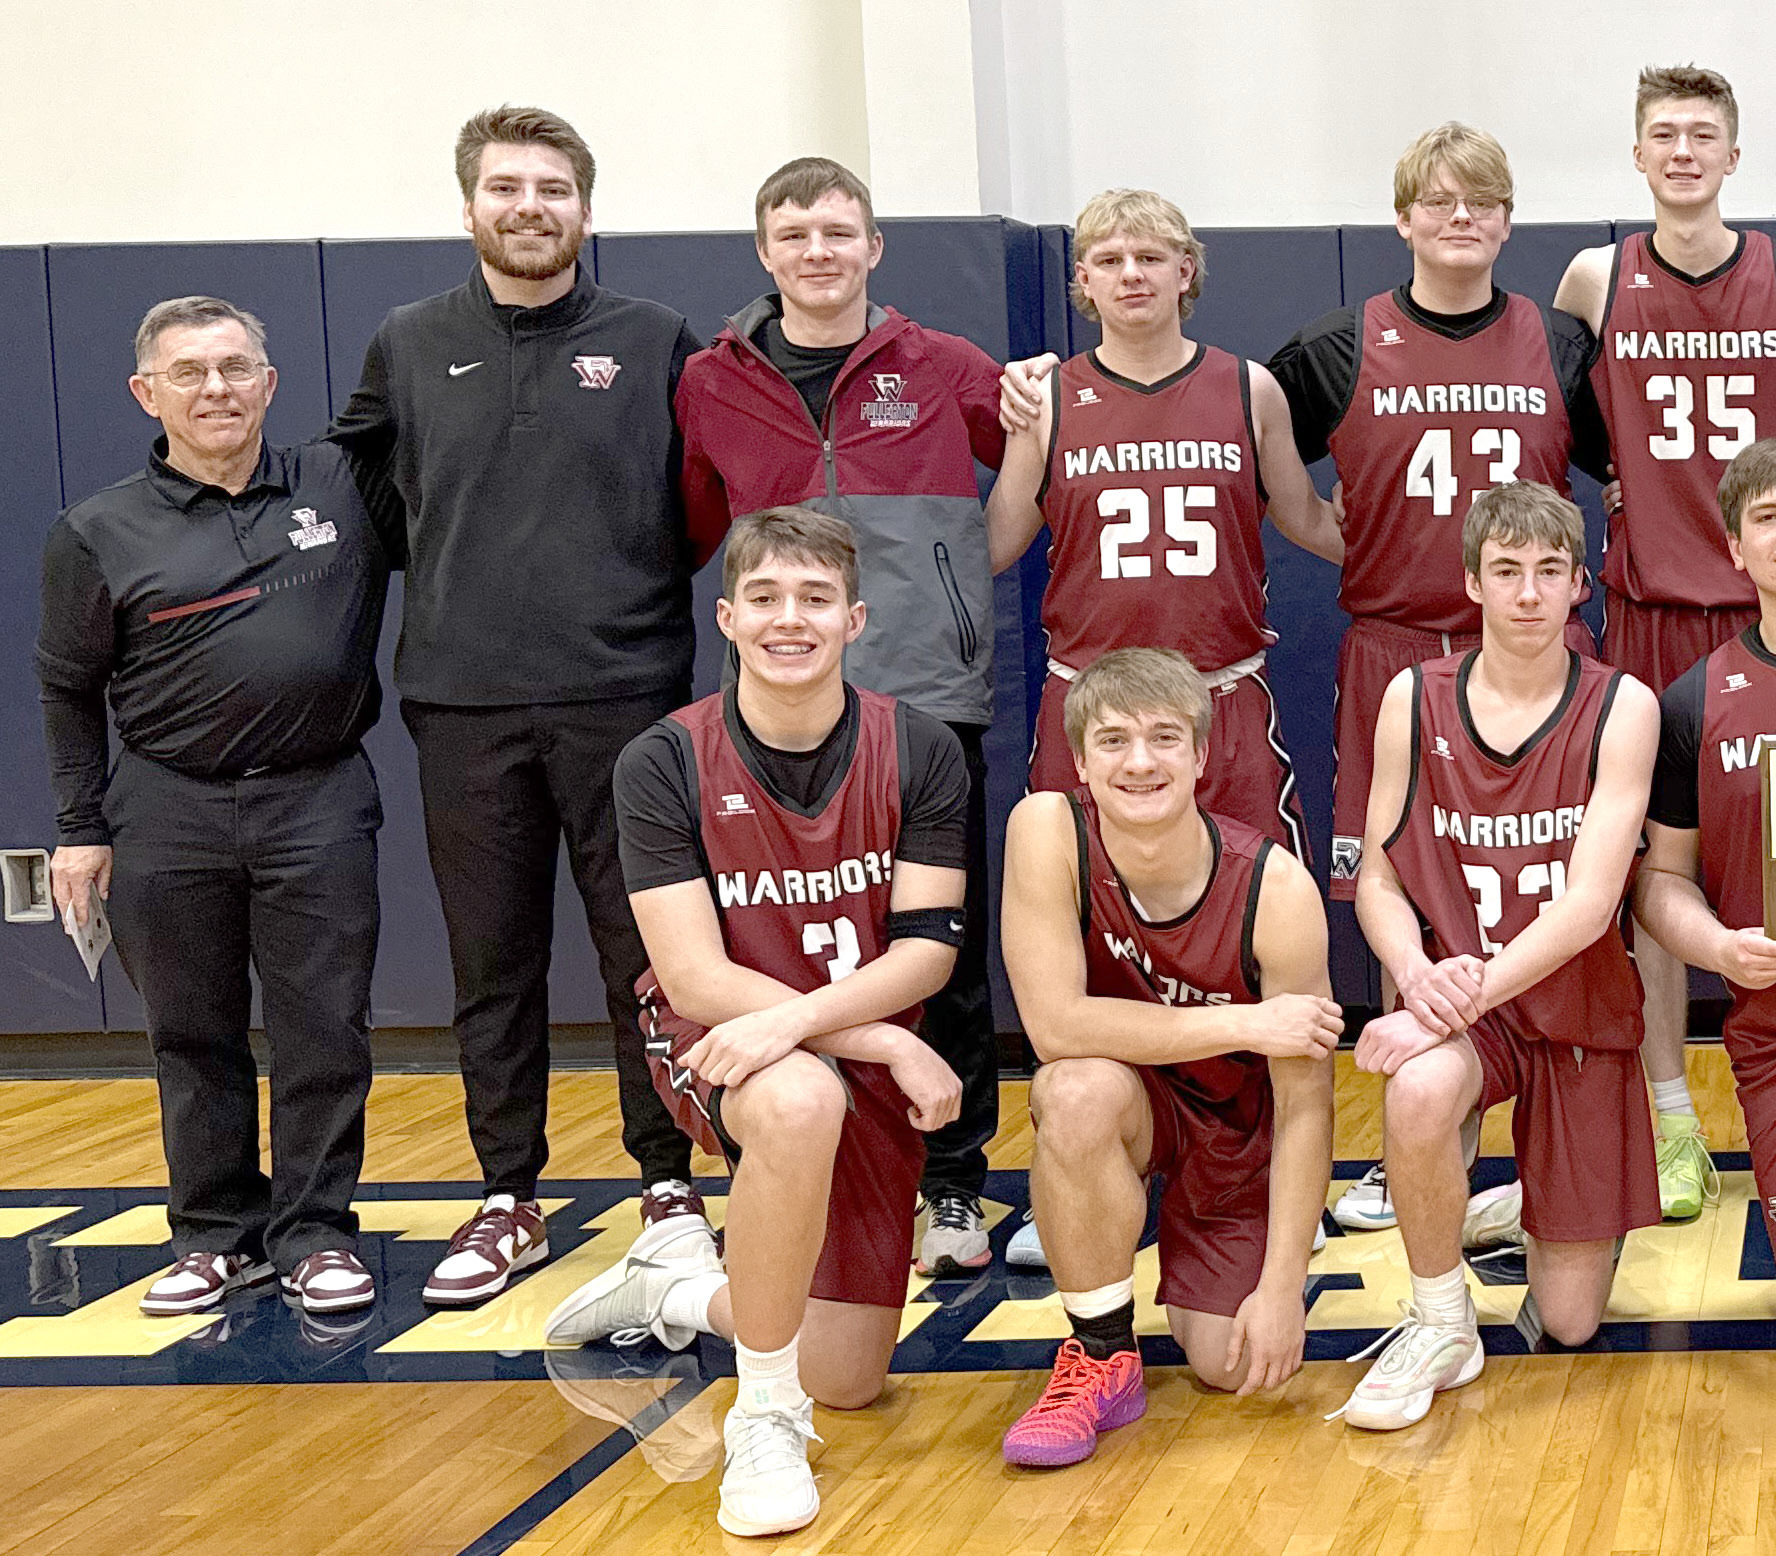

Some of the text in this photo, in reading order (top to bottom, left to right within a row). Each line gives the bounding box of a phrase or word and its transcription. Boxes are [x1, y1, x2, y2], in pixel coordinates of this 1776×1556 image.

[1373, 384, 1547, 416] WARRIORS
[1646, 375, 1756, 459] 35
[1065, 440, 1241, 479] WARRIORS
[1405, 428, 1521, 516] 43
[1097, 485, 1217, 579] 25
[1433, 804, 1585, 848] WARRIORS
